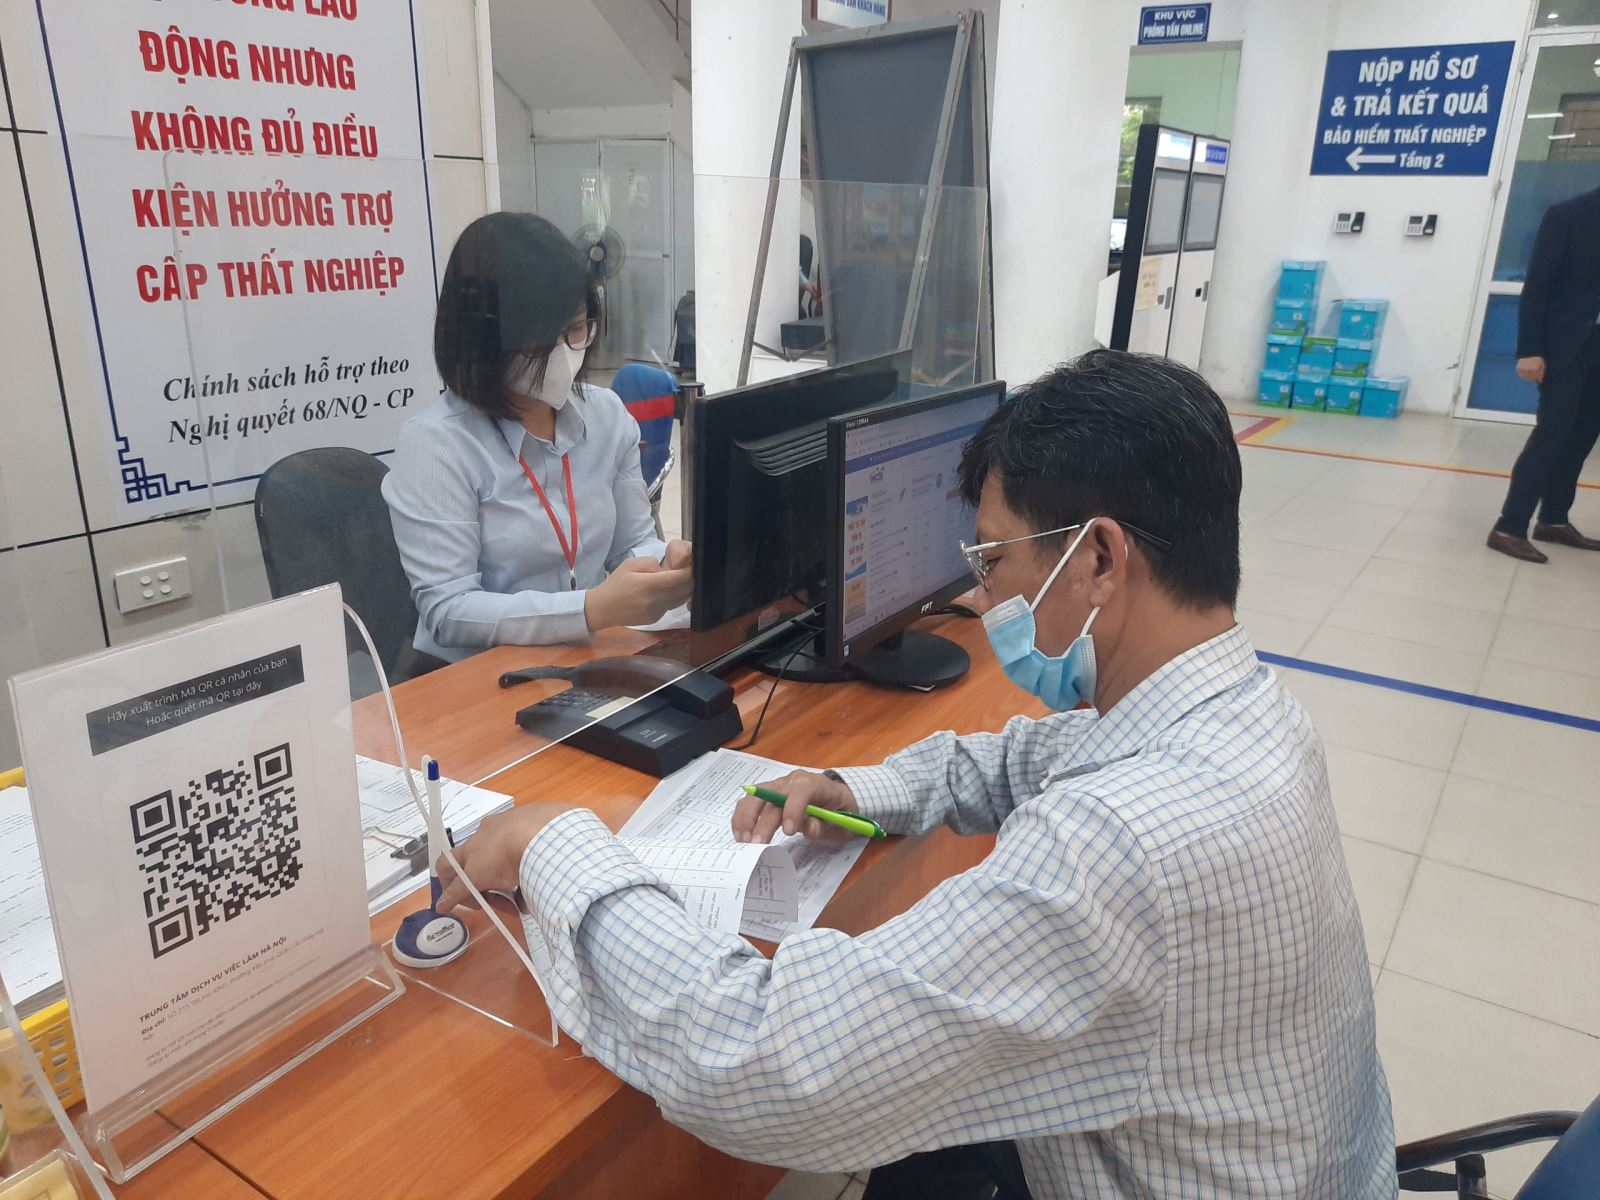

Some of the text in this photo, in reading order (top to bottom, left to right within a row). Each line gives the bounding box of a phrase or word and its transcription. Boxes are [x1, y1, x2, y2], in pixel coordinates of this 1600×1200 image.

[1154, 9, 1196, 21] KHU VỰC
[1180, 22, 1204, 36] ONLINE
[138, 25, 356, 90] ĐỘNG NHƯNG
[1358, 57, 1405, 87] NỘP
[1445, 54, 1479, 81] SƠ
[1330, 84, 1490, 117] & TRẢ KẾT QUẢ
[131, 105, 379, 160] KHÔNG ĐỦ ĐIỀU
[1323, 123, 1487, 147] BẢO HIỂM THẤT NGHIỆP
[1434, 153, 1445, 168] 2
[132, 179, 393, 236] KIỆN HƯỞNG TRỢ
[217, 247, 294, 297] THẤT
[304, 250, 404, 296] NGHIỆP
[163, 355, 410, 402] Chính sách hỗ trợ theo
[168, 411, 230, 446] Nghị
[237, 398, 297, 437] quyết
[302, 394, 368, 422] 68/NQ
[387, 387, 415, 410] CP
[920, 601, 934, 615] FPT
[106, 708, 128, 724] Hãy
[130, 701, 153, 716] xuất
[198, 680, 213, 694] QR
[215, 675, 226, 687] cá
[228, 669, 252, 683] nhân
[253, 662, 269, 675] của
[271, 656, 288, 670] bạn
[215, 690, 231, 703] QR
[139, 1003, 169, 1023] TRUNG
[171, 990, 189, 1006] TÂM
[191, 977, 211, 996] DỊCH
[212, 970, 224, 983] VỤ
[224, 961, 241, 977] VIỆC
[242, 951, 260, 966] LÀM
[272, 935, 287, 951] NỘI
